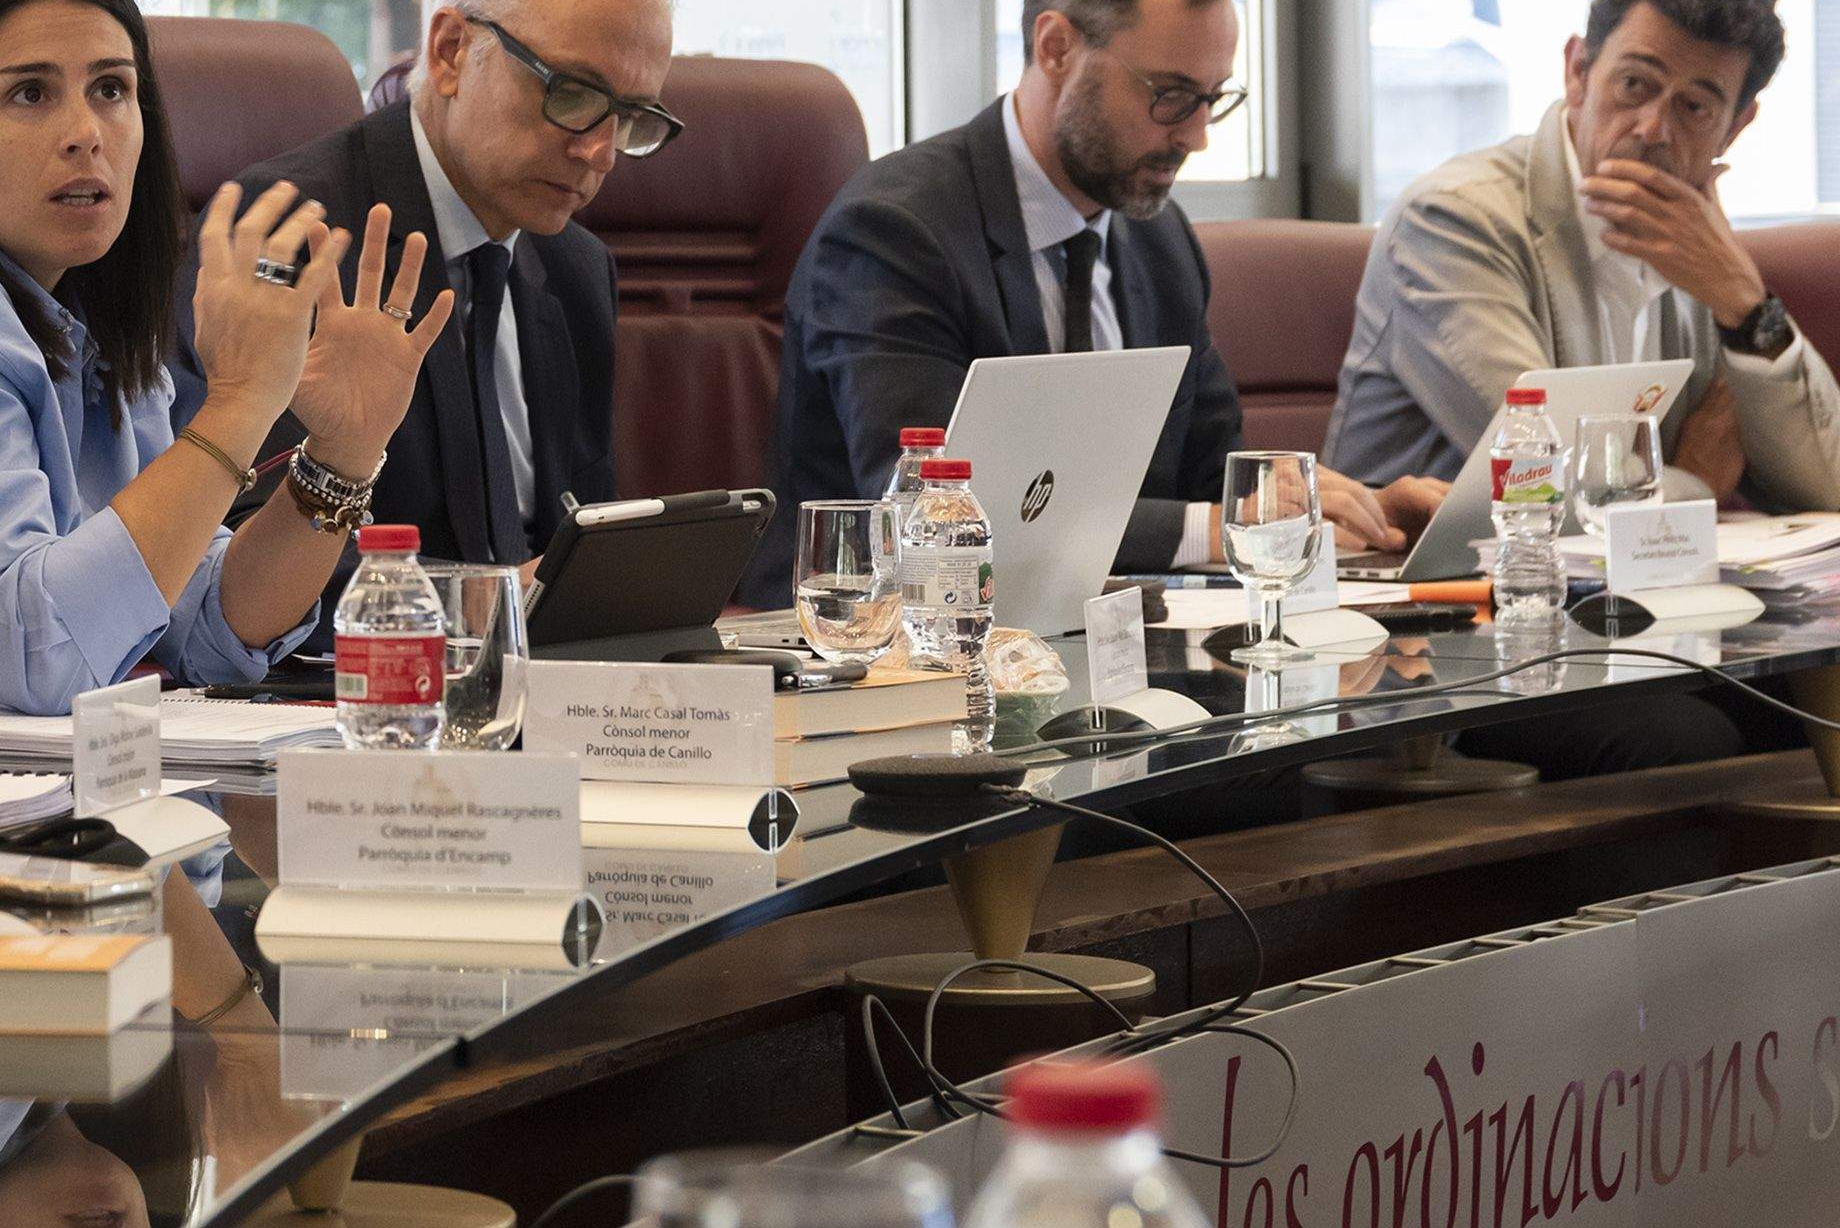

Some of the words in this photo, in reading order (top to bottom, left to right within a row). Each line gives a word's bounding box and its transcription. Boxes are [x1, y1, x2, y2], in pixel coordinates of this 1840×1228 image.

[1022, 469, 1053, 523] hp
[566, 704, 600, 718] Hble.
[602, 705, 618, 719] Sr.
[620, 706, 653, 719] Marc
[654, 706, 687, 721] Casal
[690, 707, 731, 721] Tomàs
[603, 724, 646, 739] Cònsol
[648, 728, 692, 740] menor
[585, 743, 647, 759] Parròquia
[649, 745, 666, 759] de
[668, 746, 713, 760] Canillo
[1340, 1030, 1785, 1228] ordinacions
